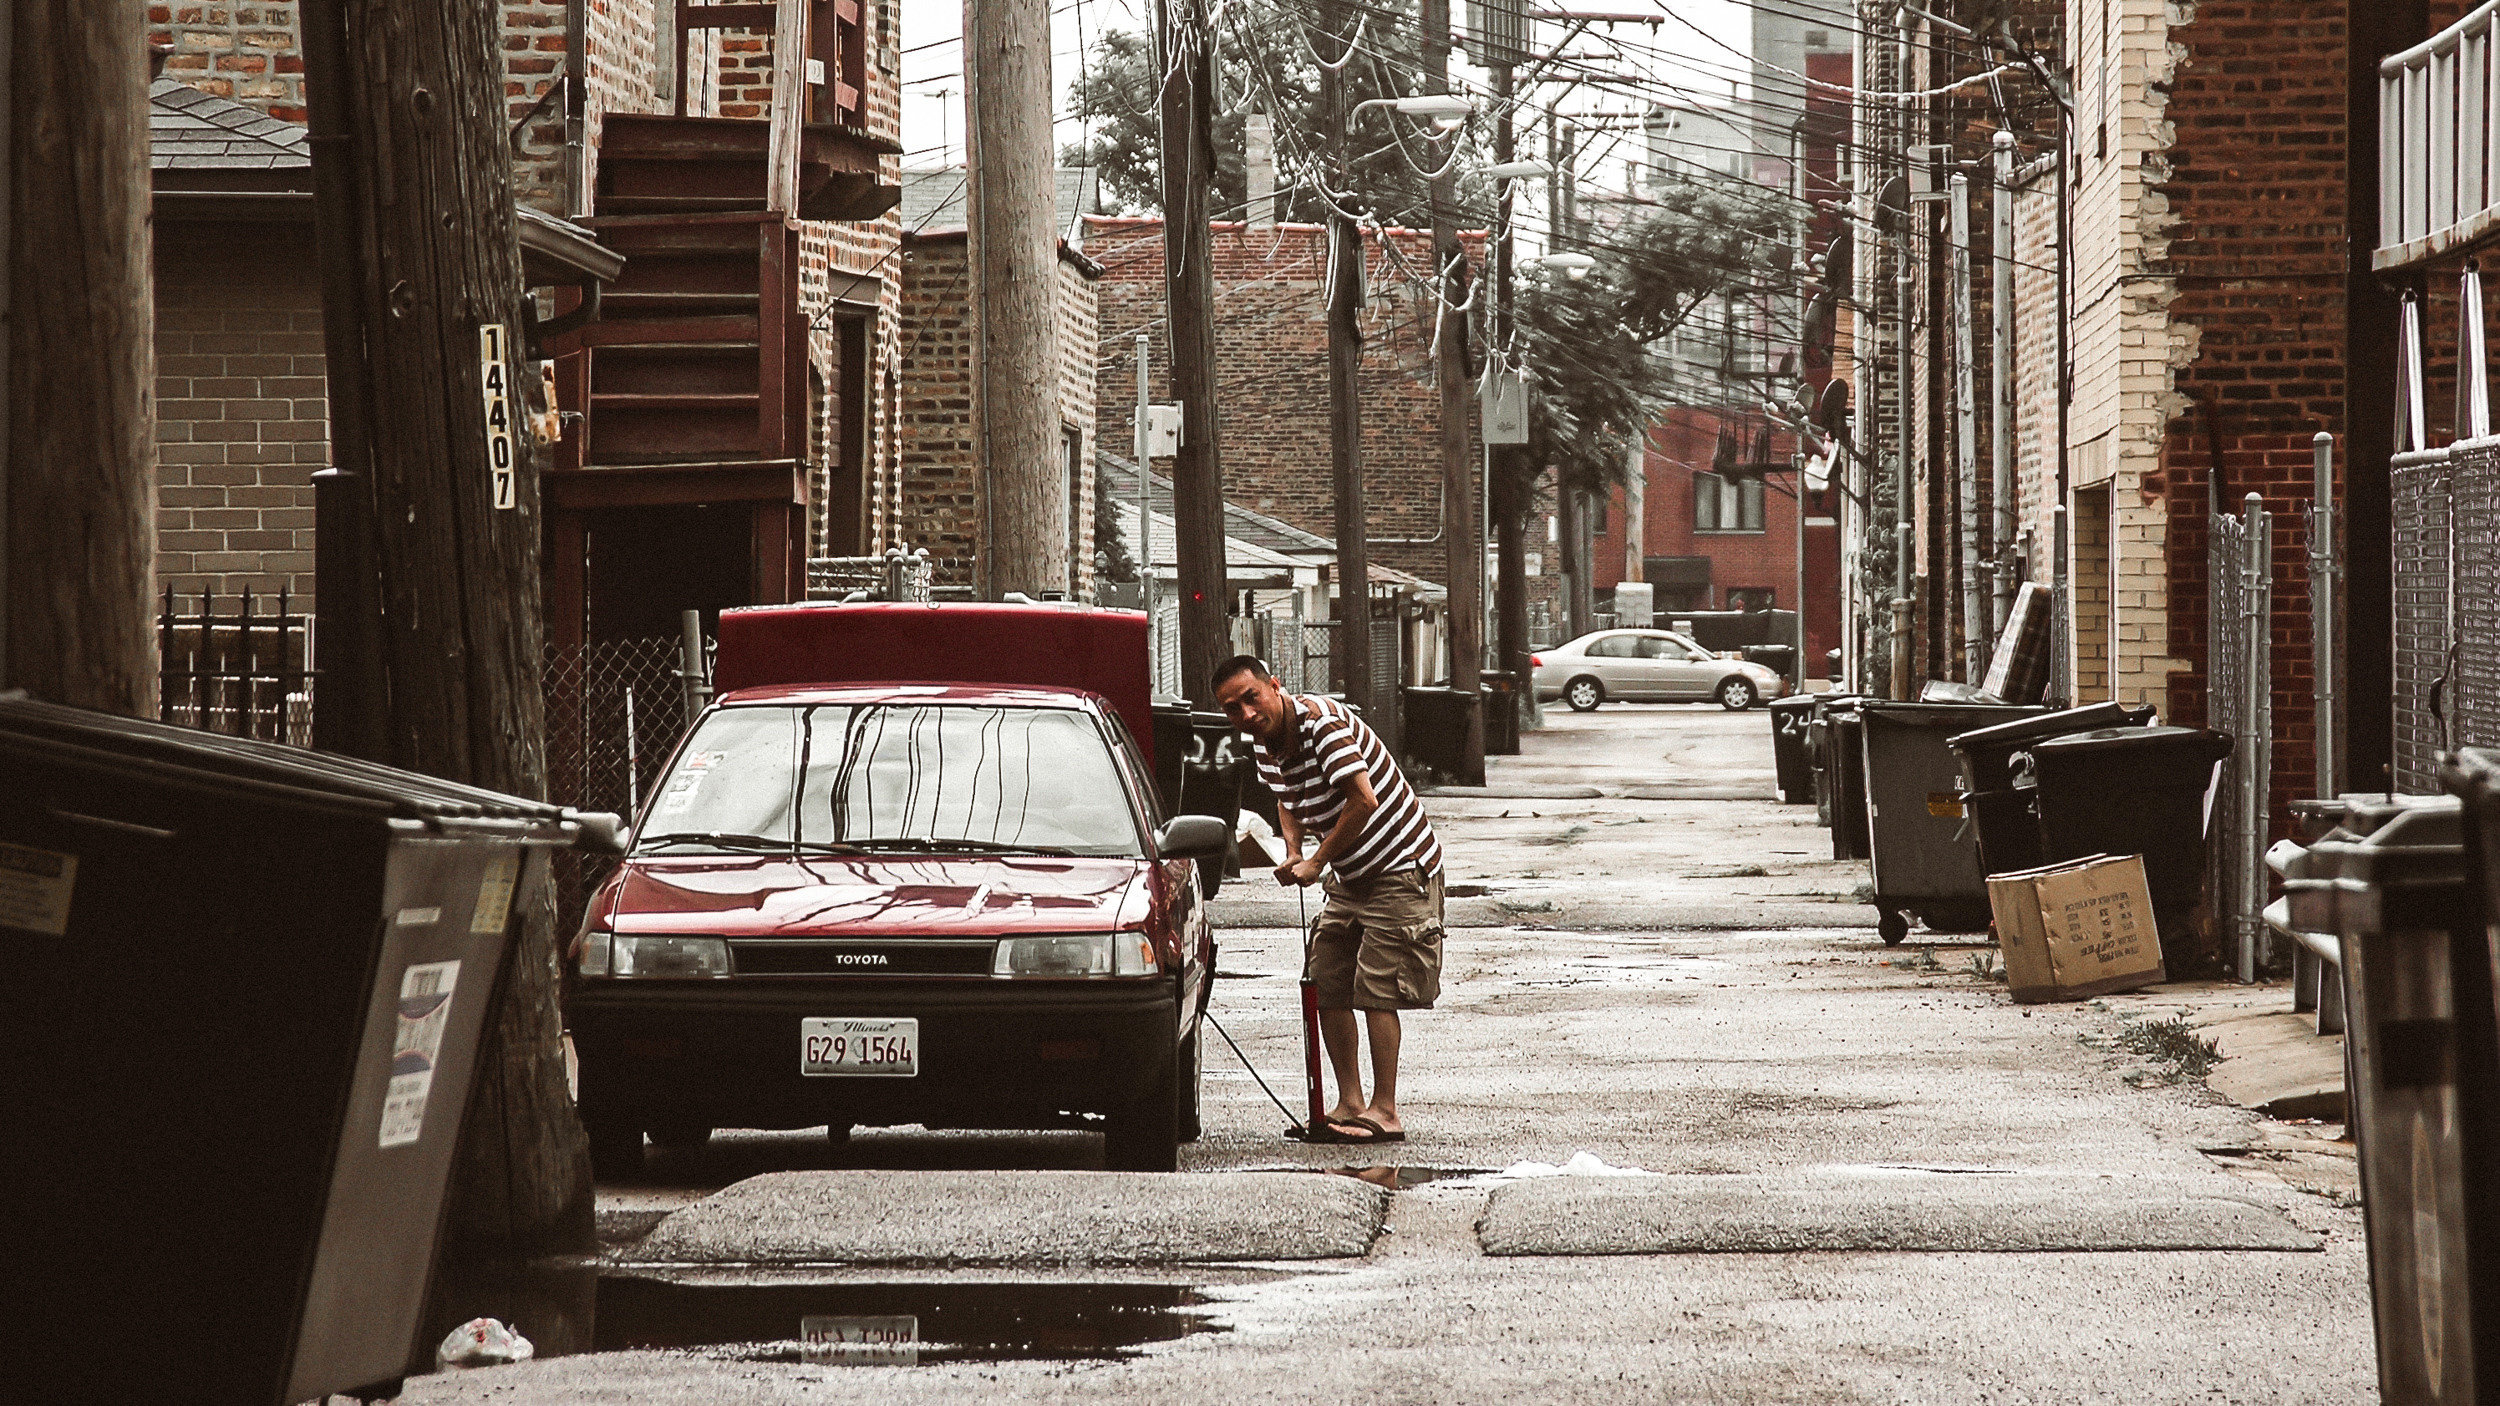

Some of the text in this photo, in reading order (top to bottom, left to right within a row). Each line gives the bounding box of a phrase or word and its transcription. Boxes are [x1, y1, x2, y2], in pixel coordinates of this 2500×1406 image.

[486, 327, 509, 505] 14407
[836, 955, 888, 965] TOYOTA
[843, 1021, 890, 1032] Illinois
[806, 1036, 912, 1064] G29 1564
